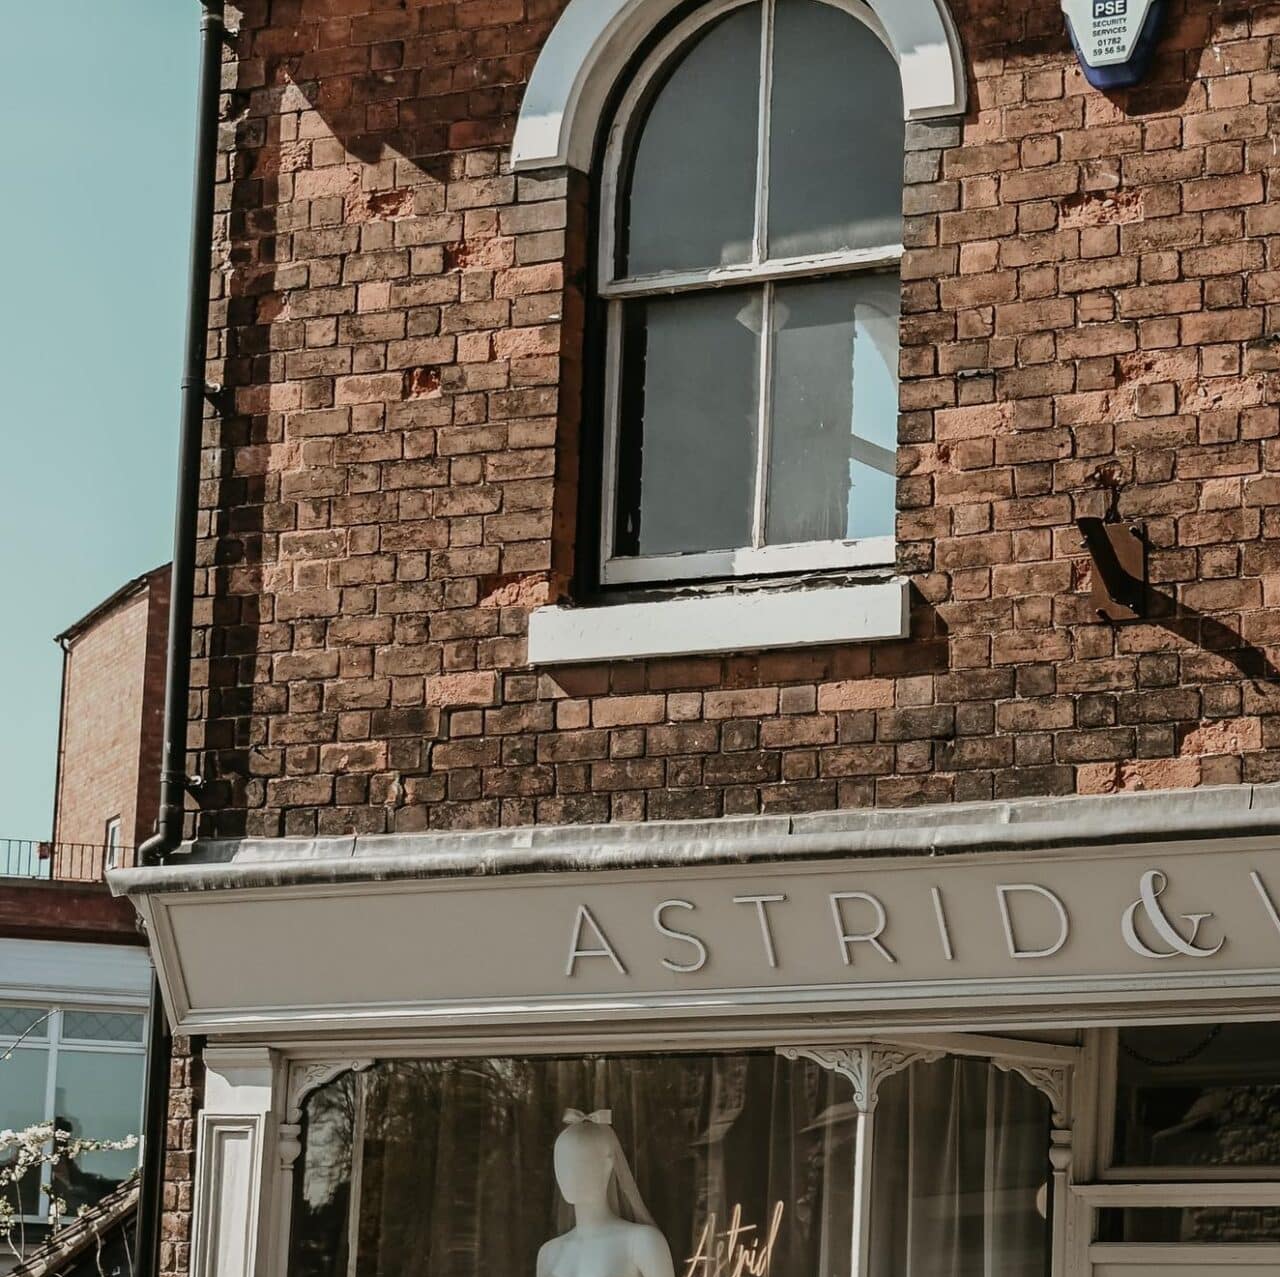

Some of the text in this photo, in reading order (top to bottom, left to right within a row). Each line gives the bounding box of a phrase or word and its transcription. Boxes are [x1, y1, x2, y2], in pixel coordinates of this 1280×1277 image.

[1095, 0, 1125, 16] PSE
[1093, 18, 1127, 28] SECURITY
[1092, 26, 1127, 37] SERVICES
[1097, 37, 1121, 46] 01782
[565, 883, 1070, 977] ASTRID
[1120, 869, 1226, 958] &
